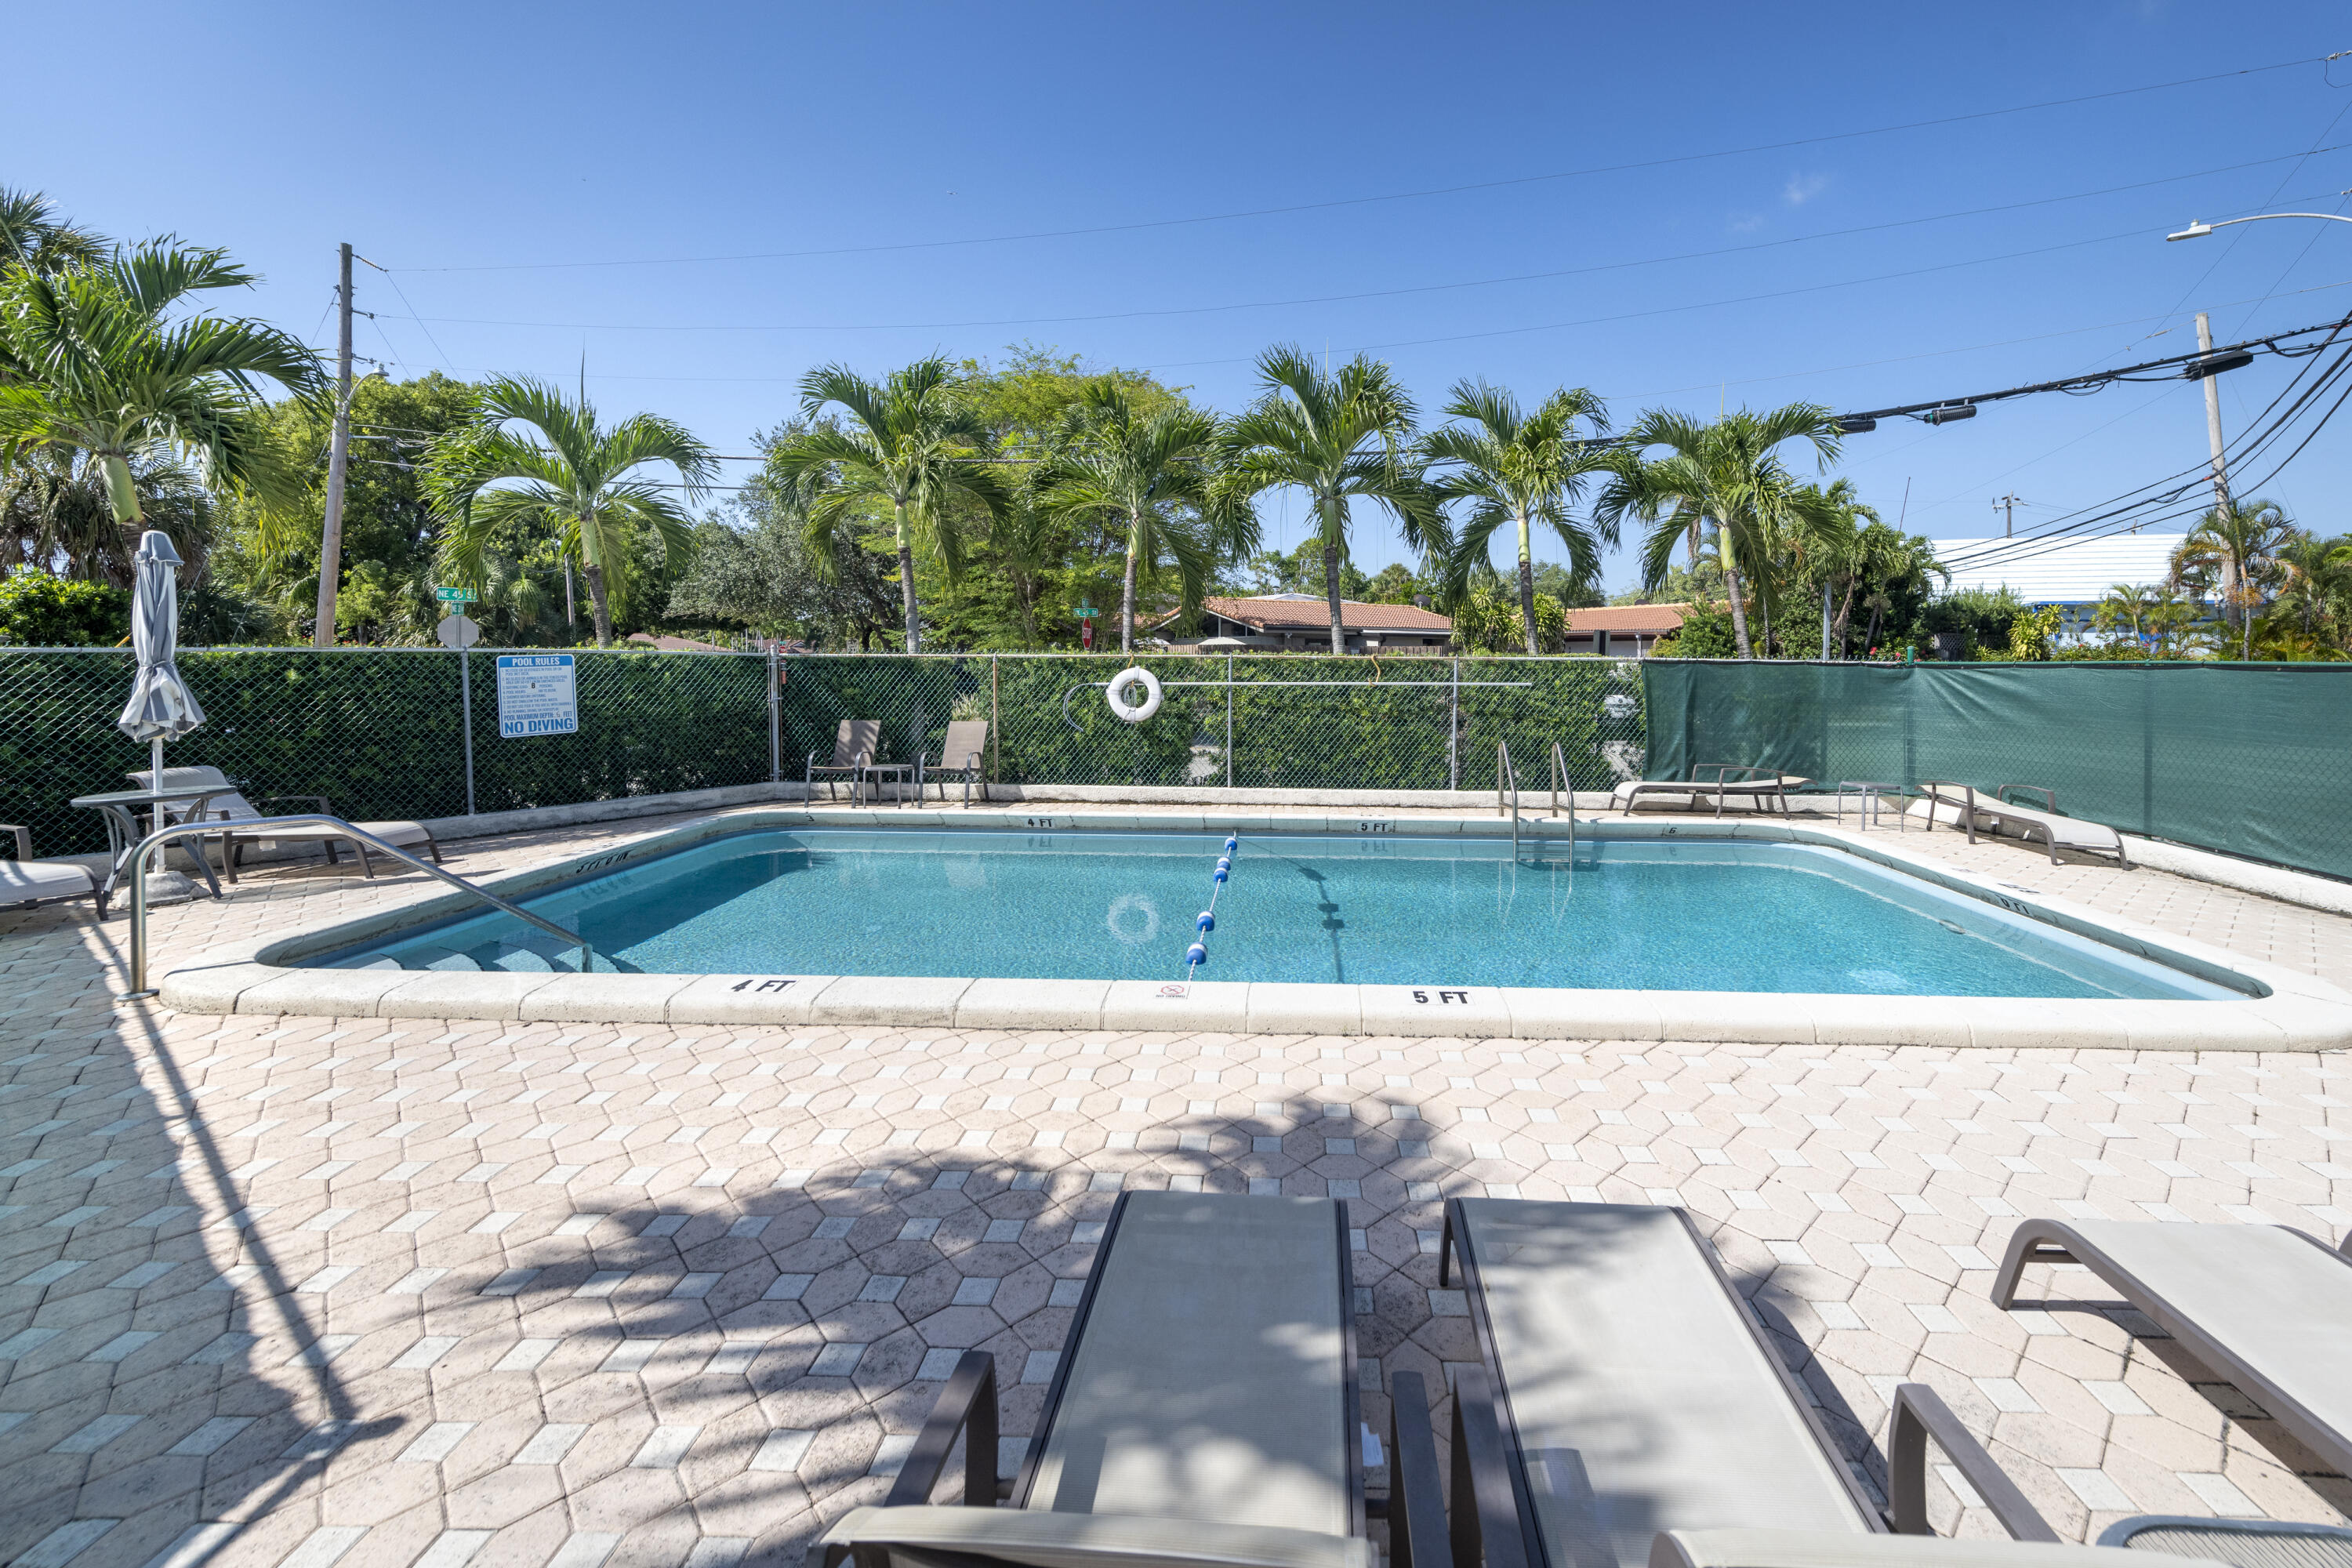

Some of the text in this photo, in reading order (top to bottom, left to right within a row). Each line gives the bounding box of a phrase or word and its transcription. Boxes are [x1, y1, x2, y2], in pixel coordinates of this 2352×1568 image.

[439, 590, 449, 598] NE
[512, 657, 560, 666] POOL RULES
[505, 717, 573, 734] NO DIVING
[1027, 818, 1052, 827] 4 FT
[1360, 822, 1388, 832] 5 FT
[731, 979, 797, 993] 4 FT
[1413, 990, 1468, 1004] 5 FT
